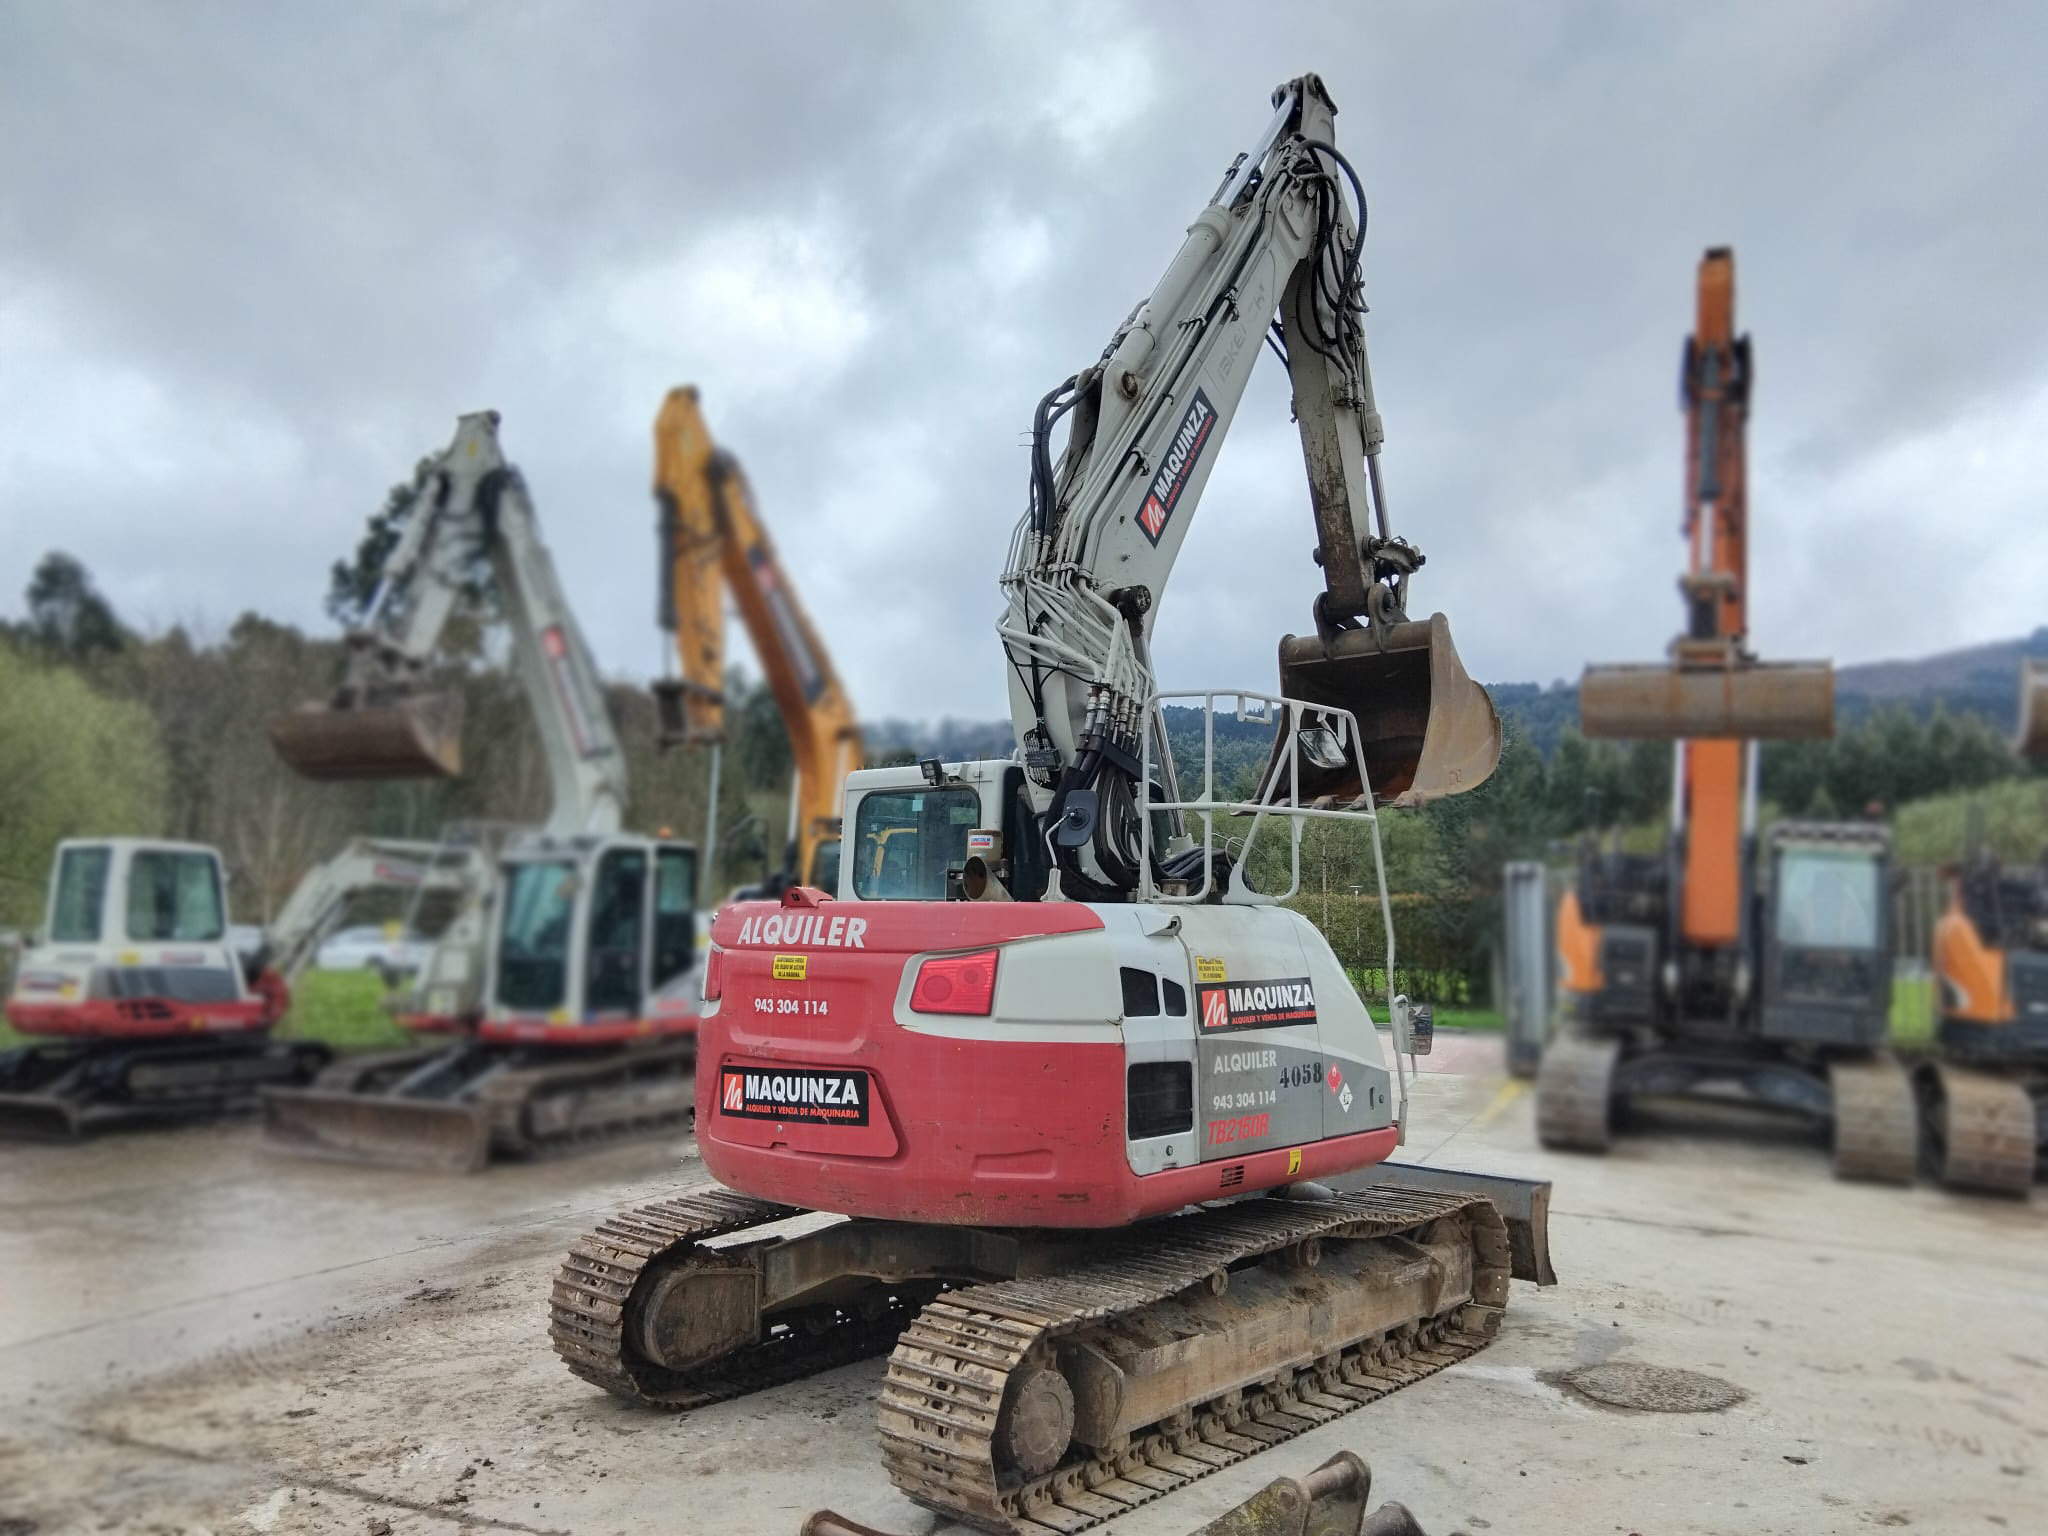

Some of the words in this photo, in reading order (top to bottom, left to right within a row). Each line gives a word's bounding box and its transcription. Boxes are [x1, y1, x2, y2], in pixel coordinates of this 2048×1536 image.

[1154, 400, 1208, 503] MAQUINZA
[737, 914, 867, 948] ALQUILER
[754, 998, 774, 1013] 943
[777, 999, 799, 1014] 304
[804, 1000, 828, 1015] 114
[1228, 984, 1315, 1012] MAQUINZA
[1214, 1050, 1278, 1074] ALQUILER
[1279, 1062, 1322, 1088] 4058
[745, 1074, 860, 1105] MAQUINZA
[1213, 1095, 1233, 1110] 943
[1236, 1092, 1255, 1108] 304
[1258, 1089, 1276, 1105] 114
[746, 1103, 771, 1114] ALQUILER
[772, 1105, 777, 1113] Y
[778, 1106, 798, 1115] VENTA
[800, 1107, 808, 1116] DE
[810, 1108, 859, 1119] MAQUINARIA
[1208, 1113, 1270, 1146] TB2150R
